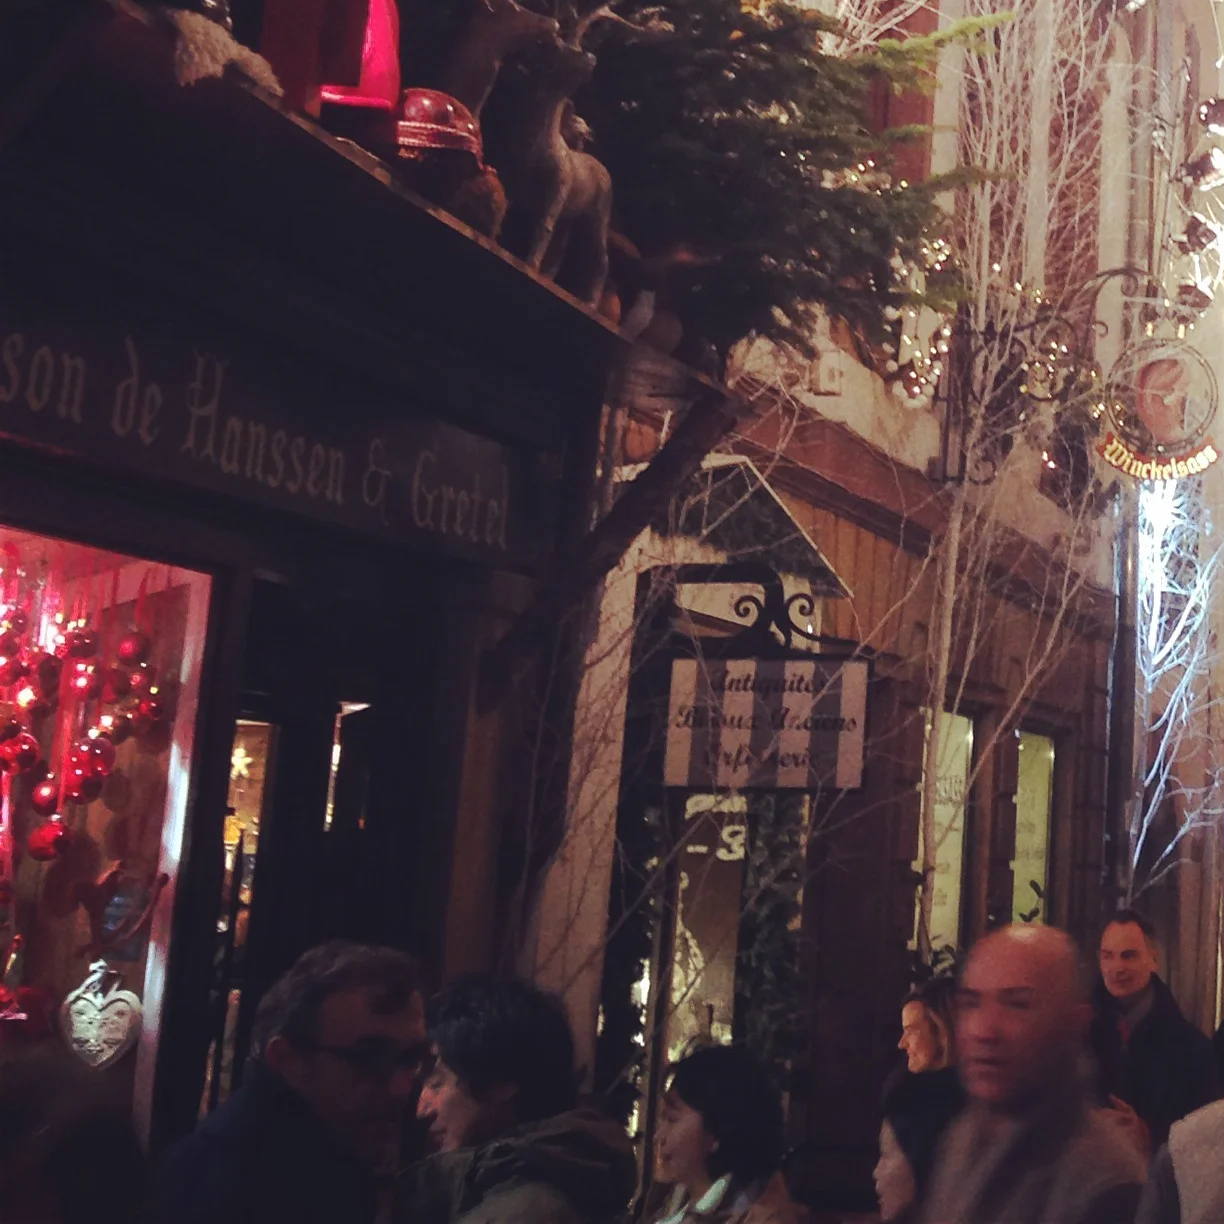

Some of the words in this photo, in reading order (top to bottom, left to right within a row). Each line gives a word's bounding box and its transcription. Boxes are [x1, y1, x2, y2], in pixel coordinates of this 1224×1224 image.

[110, 335, 163, 445] de
[180, 347, 346, 506] Hanssen
[361, 436, 392, 526] &
[411, 444, 511, 551] Gretel
